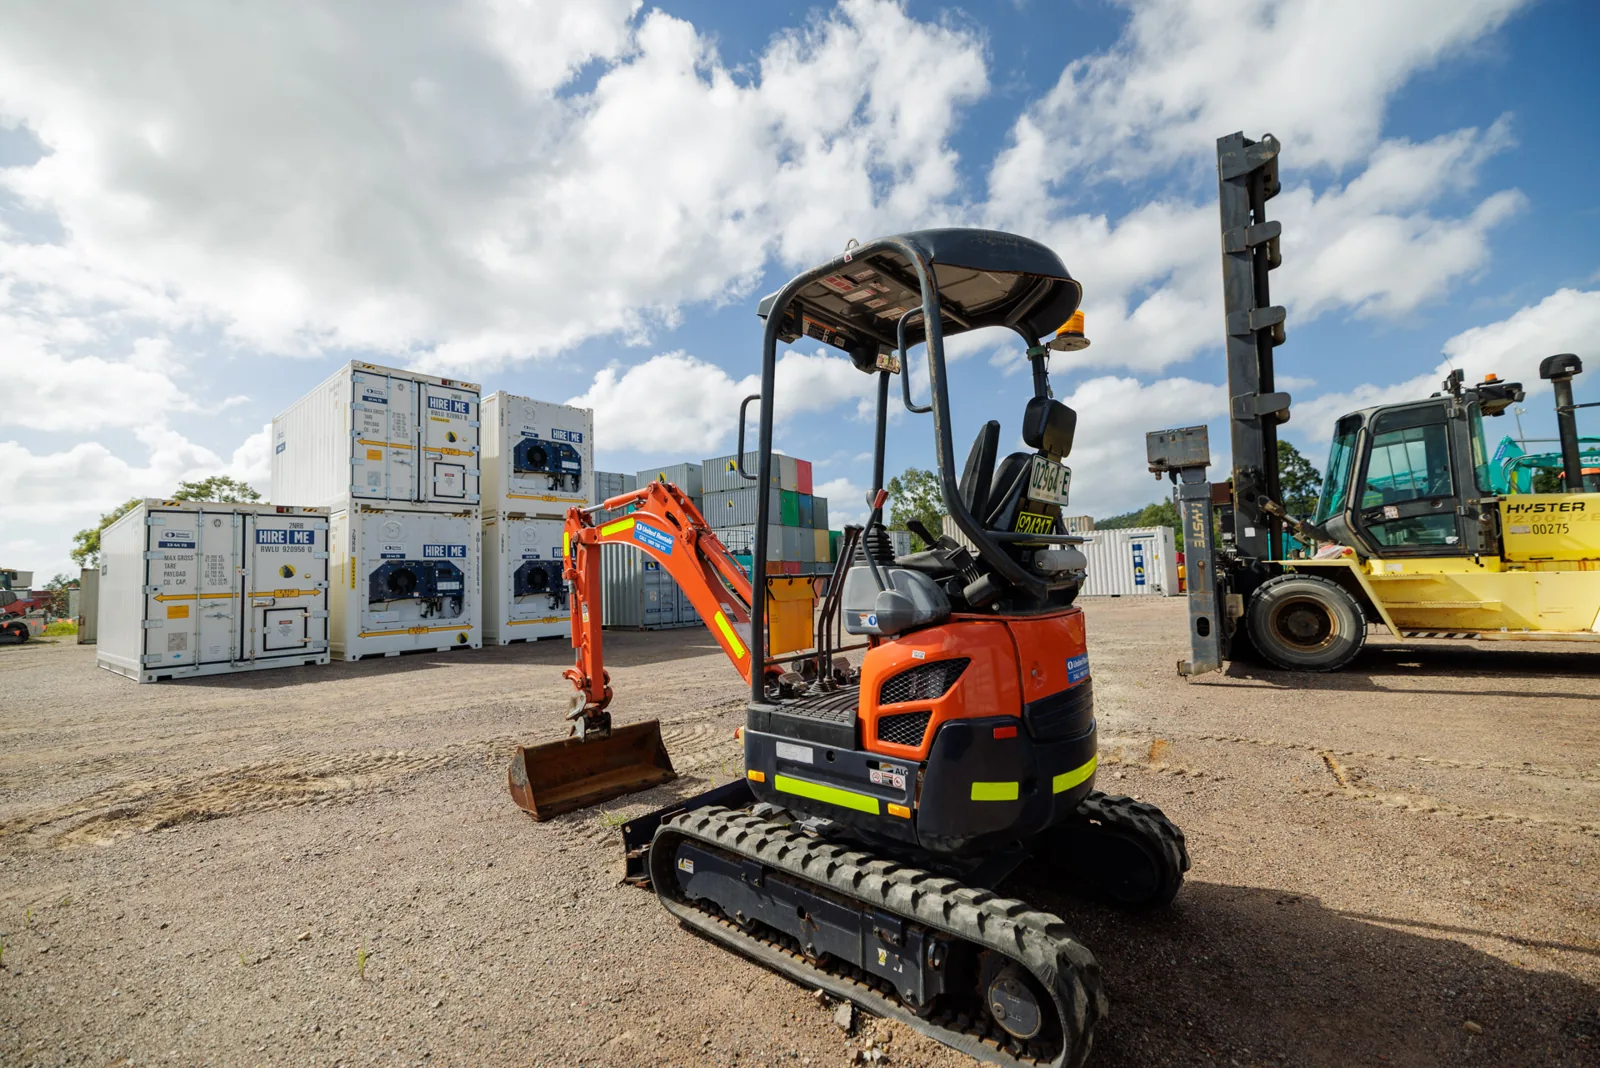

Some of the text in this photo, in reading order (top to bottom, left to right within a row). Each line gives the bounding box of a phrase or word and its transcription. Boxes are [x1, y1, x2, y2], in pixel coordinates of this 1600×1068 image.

[430, 397, 466, 412] HIRE ME
[553, 430, 580, 442] HIRE ME
[1506, 502, 1585, 513] HYSTER
[642, 527, 673, 544] United Rentals
[1532, 524, 1569, 535] 00275
[259, 531, 309, 543] HIRE ME
[426, 546, 462, 556] HIRE ME
